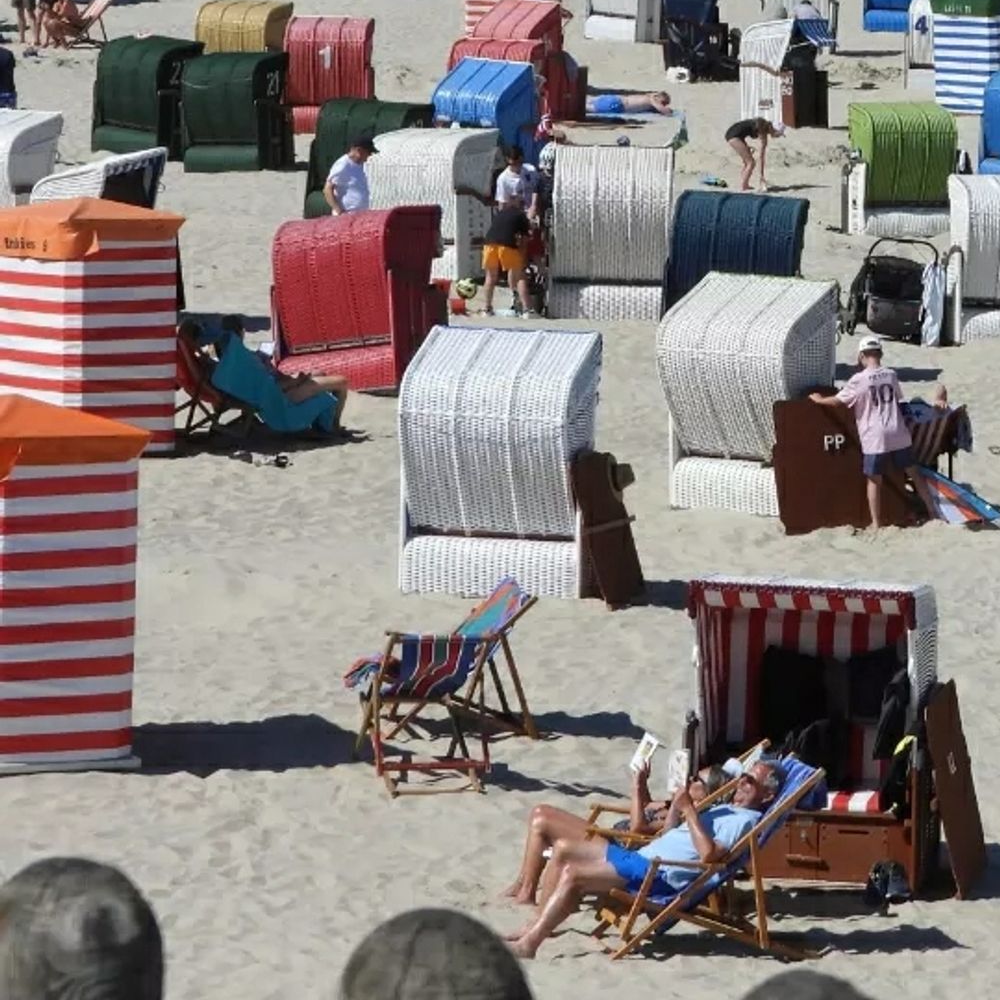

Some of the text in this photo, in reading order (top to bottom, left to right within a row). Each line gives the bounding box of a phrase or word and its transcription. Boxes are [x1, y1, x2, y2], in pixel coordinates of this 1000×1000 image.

[914, 14, 929, 35] 4
[318, 44, 332, 70] 1
[823, 433, 845, 451] PP
